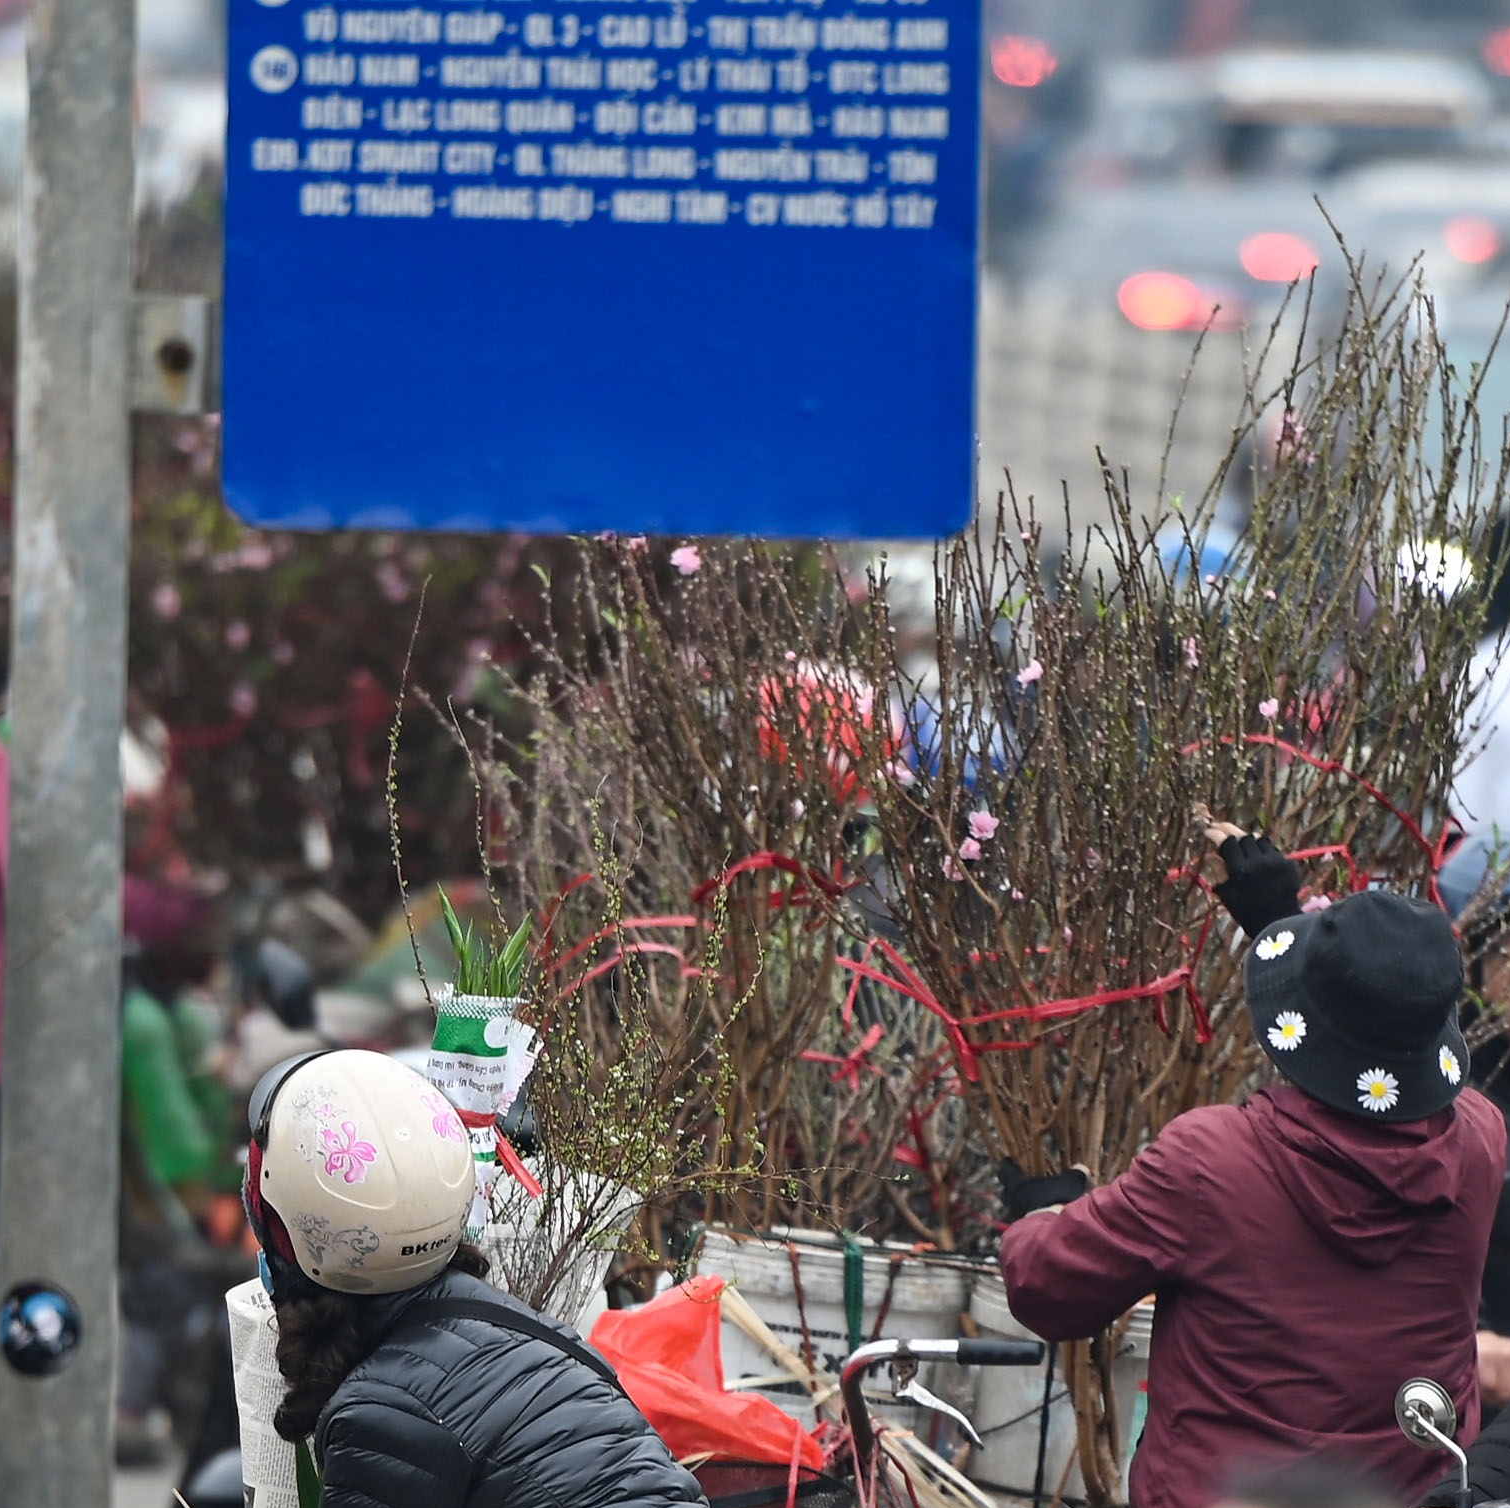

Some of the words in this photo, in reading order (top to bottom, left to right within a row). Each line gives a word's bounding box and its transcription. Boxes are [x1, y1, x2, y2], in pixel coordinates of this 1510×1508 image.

[560, 14, 579, 47] 3
[359, 54, 420, 87] NAM
[881, 62, 951, 95] LONG
[434, 99, 501, 132] LONG
[888, 106, 950, 139] NAM
[631, 147, 697, 179] LONG
